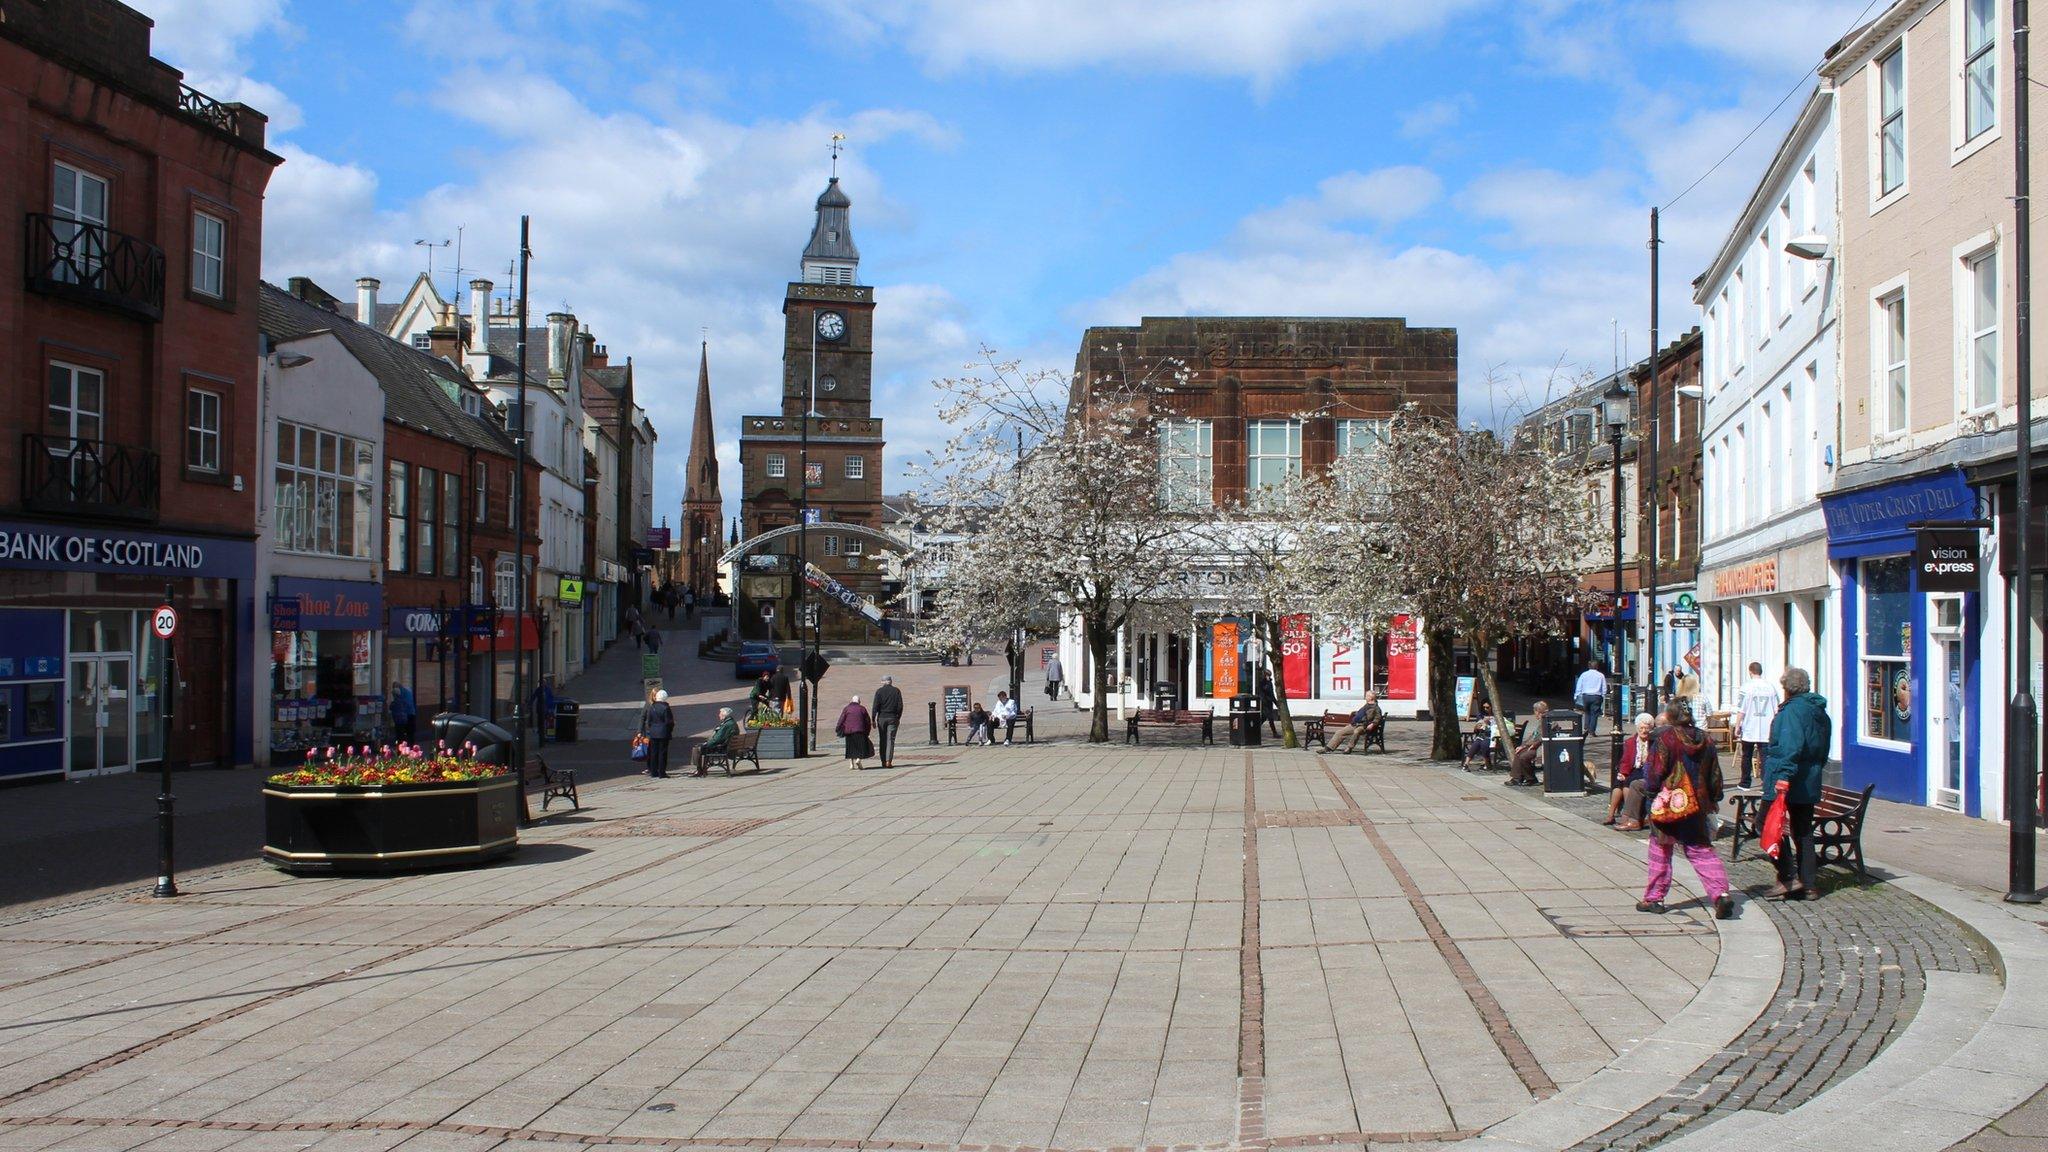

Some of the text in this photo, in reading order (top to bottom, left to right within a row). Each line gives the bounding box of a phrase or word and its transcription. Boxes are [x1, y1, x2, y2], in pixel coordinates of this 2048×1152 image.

[1829, 488, 1959, 526] THE UPPER CRUST DELL
[0, 532, 203, 569] BANK OF SCOTLAND
[1931, 547, 1968, 559] vision
[1924, 562, 1975, 575] express
[274, 604, 297, 616] Shoe
[296, 592, 369, 617] Shoe Zone
[157, 616, 174, 629] 20
[273, 617, 296, 629] Zone
[1283, 630, 1308, 639] SALE
[1752, 696, 1770, 717] 17
